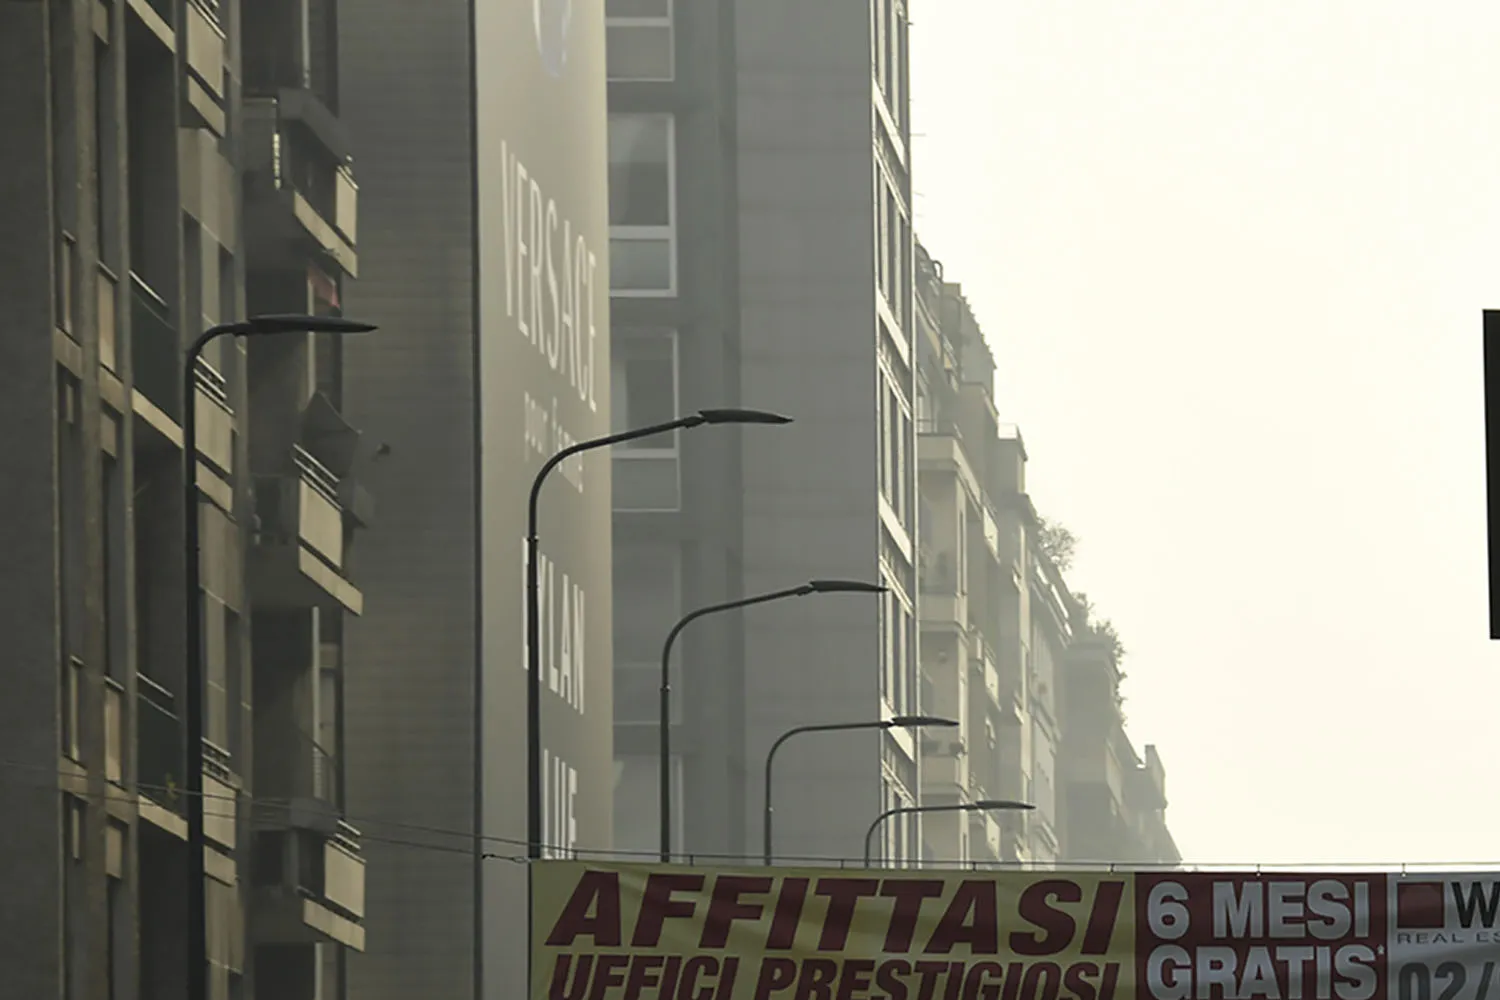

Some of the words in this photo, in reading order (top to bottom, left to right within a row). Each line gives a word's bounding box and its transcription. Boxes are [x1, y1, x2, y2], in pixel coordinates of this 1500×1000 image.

[501, 139, 596, 412] VERSACE
[544, 870, 1125, 955] AFFITTASI
[1147, 881, 1190, 940] 6
[1212, 879, 1370, 940] MESI
[1397, 931, 1465, 945] REAL
